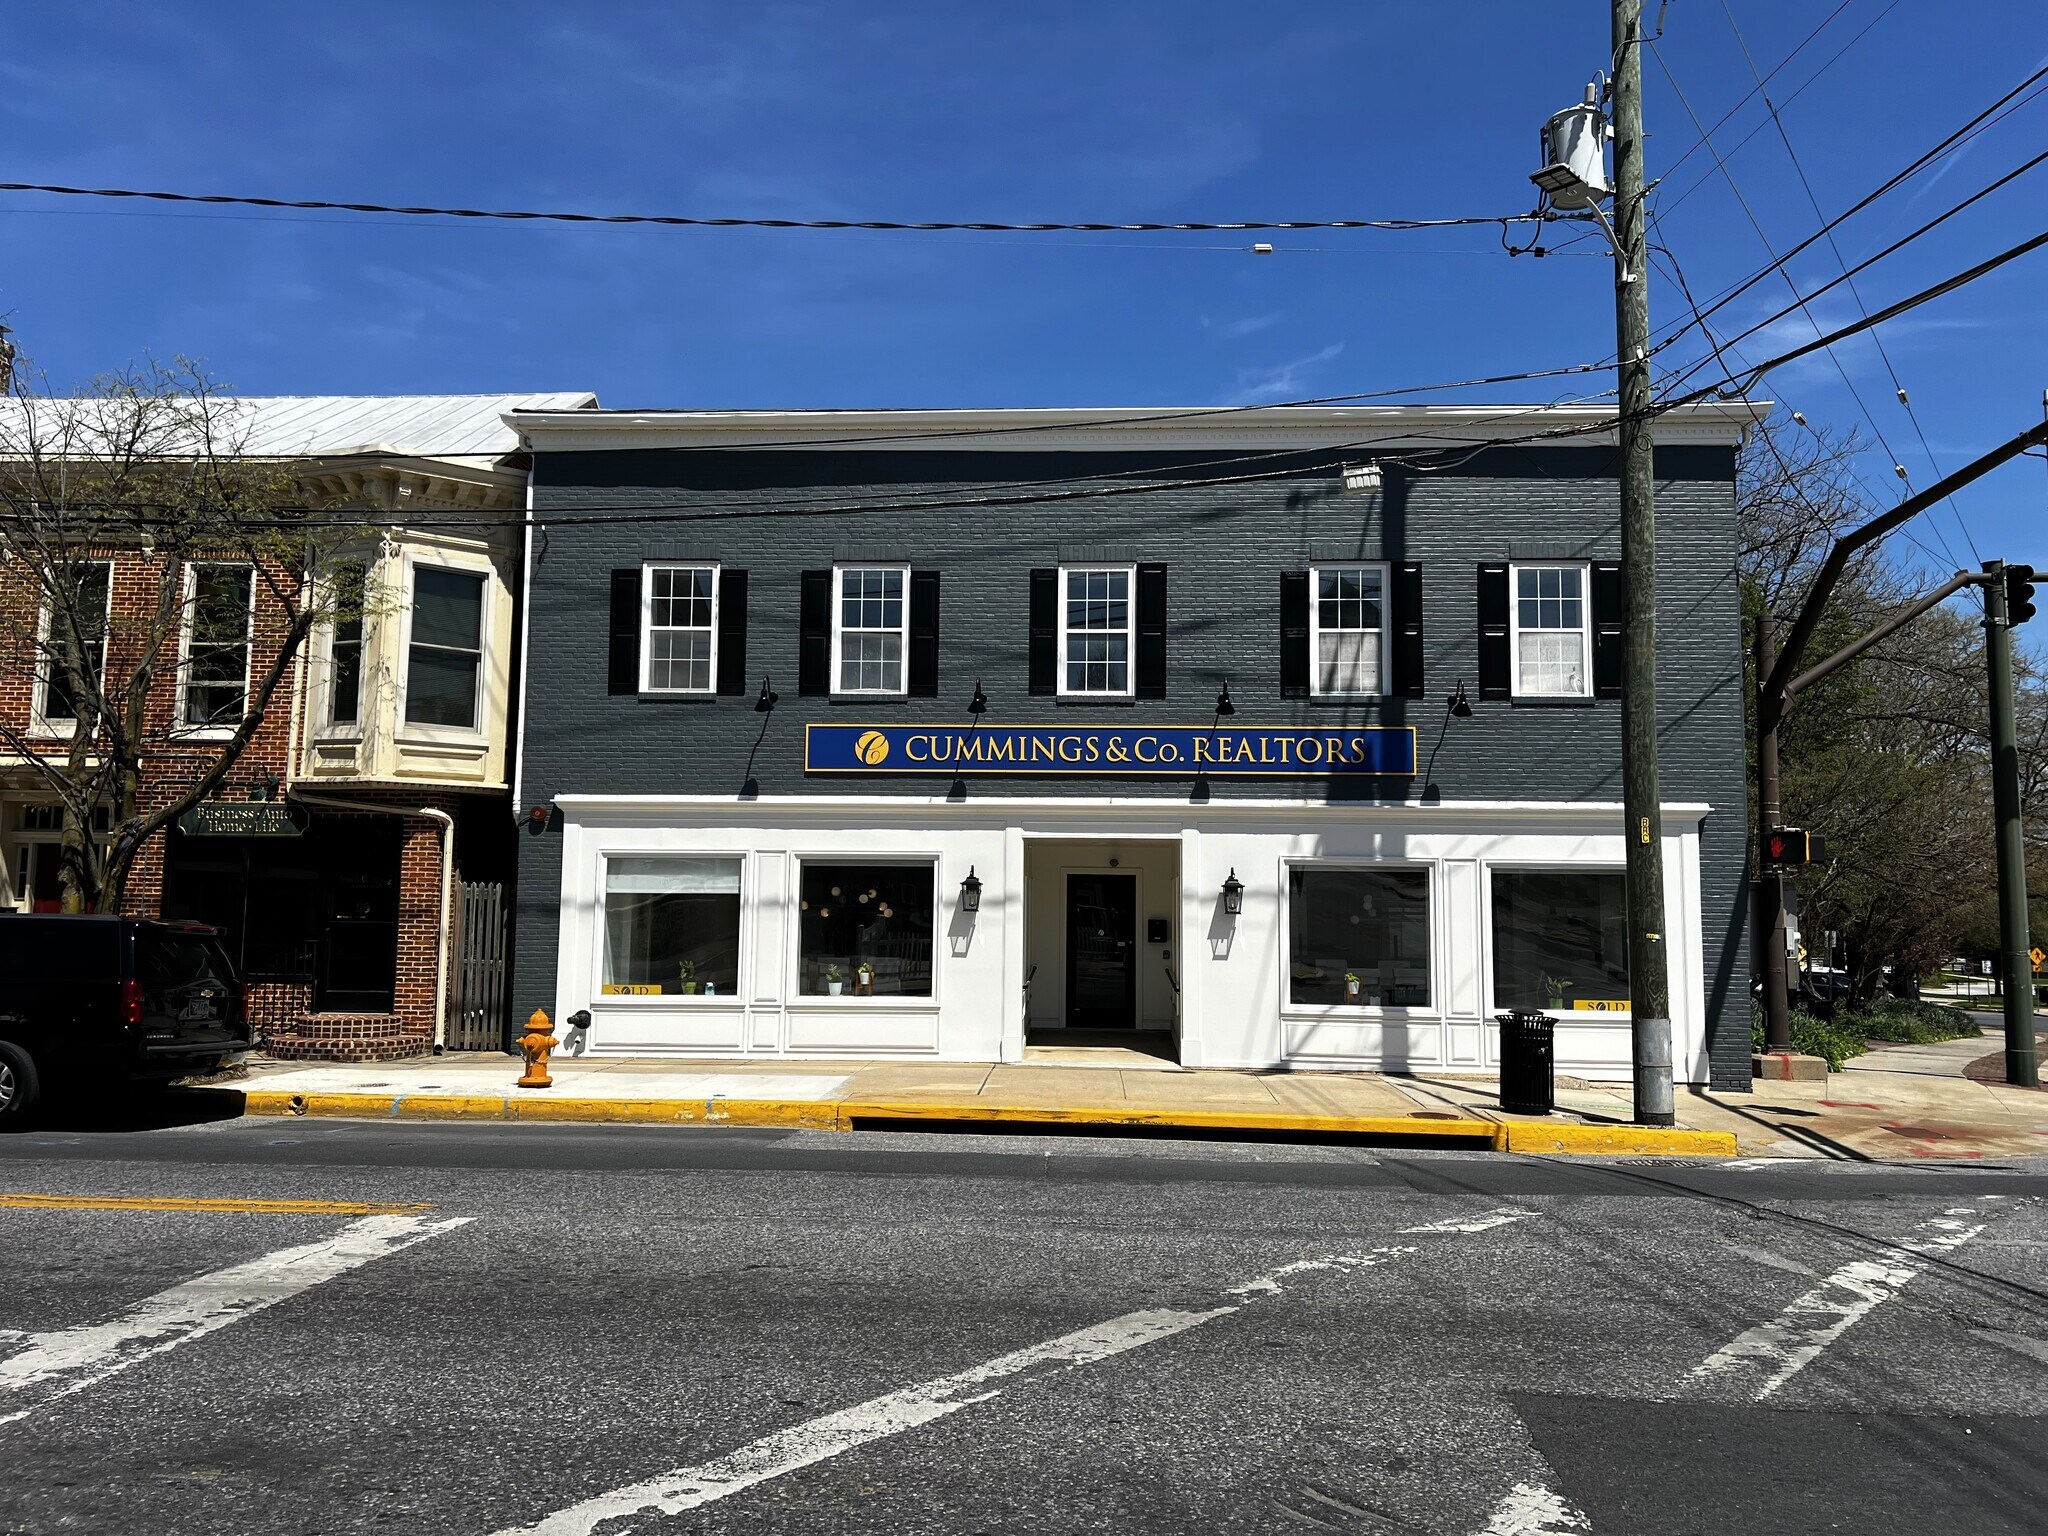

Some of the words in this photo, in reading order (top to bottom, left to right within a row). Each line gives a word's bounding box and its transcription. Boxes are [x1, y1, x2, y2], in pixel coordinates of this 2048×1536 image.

[905, 735, 1100, 762] CUMMINGS
[1192, 737, 1366, 763] REALTORS
[197, 807, 255, 819] Business
[262, 808, 293, 820] Auto
[208, 820, 247, 832] Home
[254, 820, 280, 832] Life
